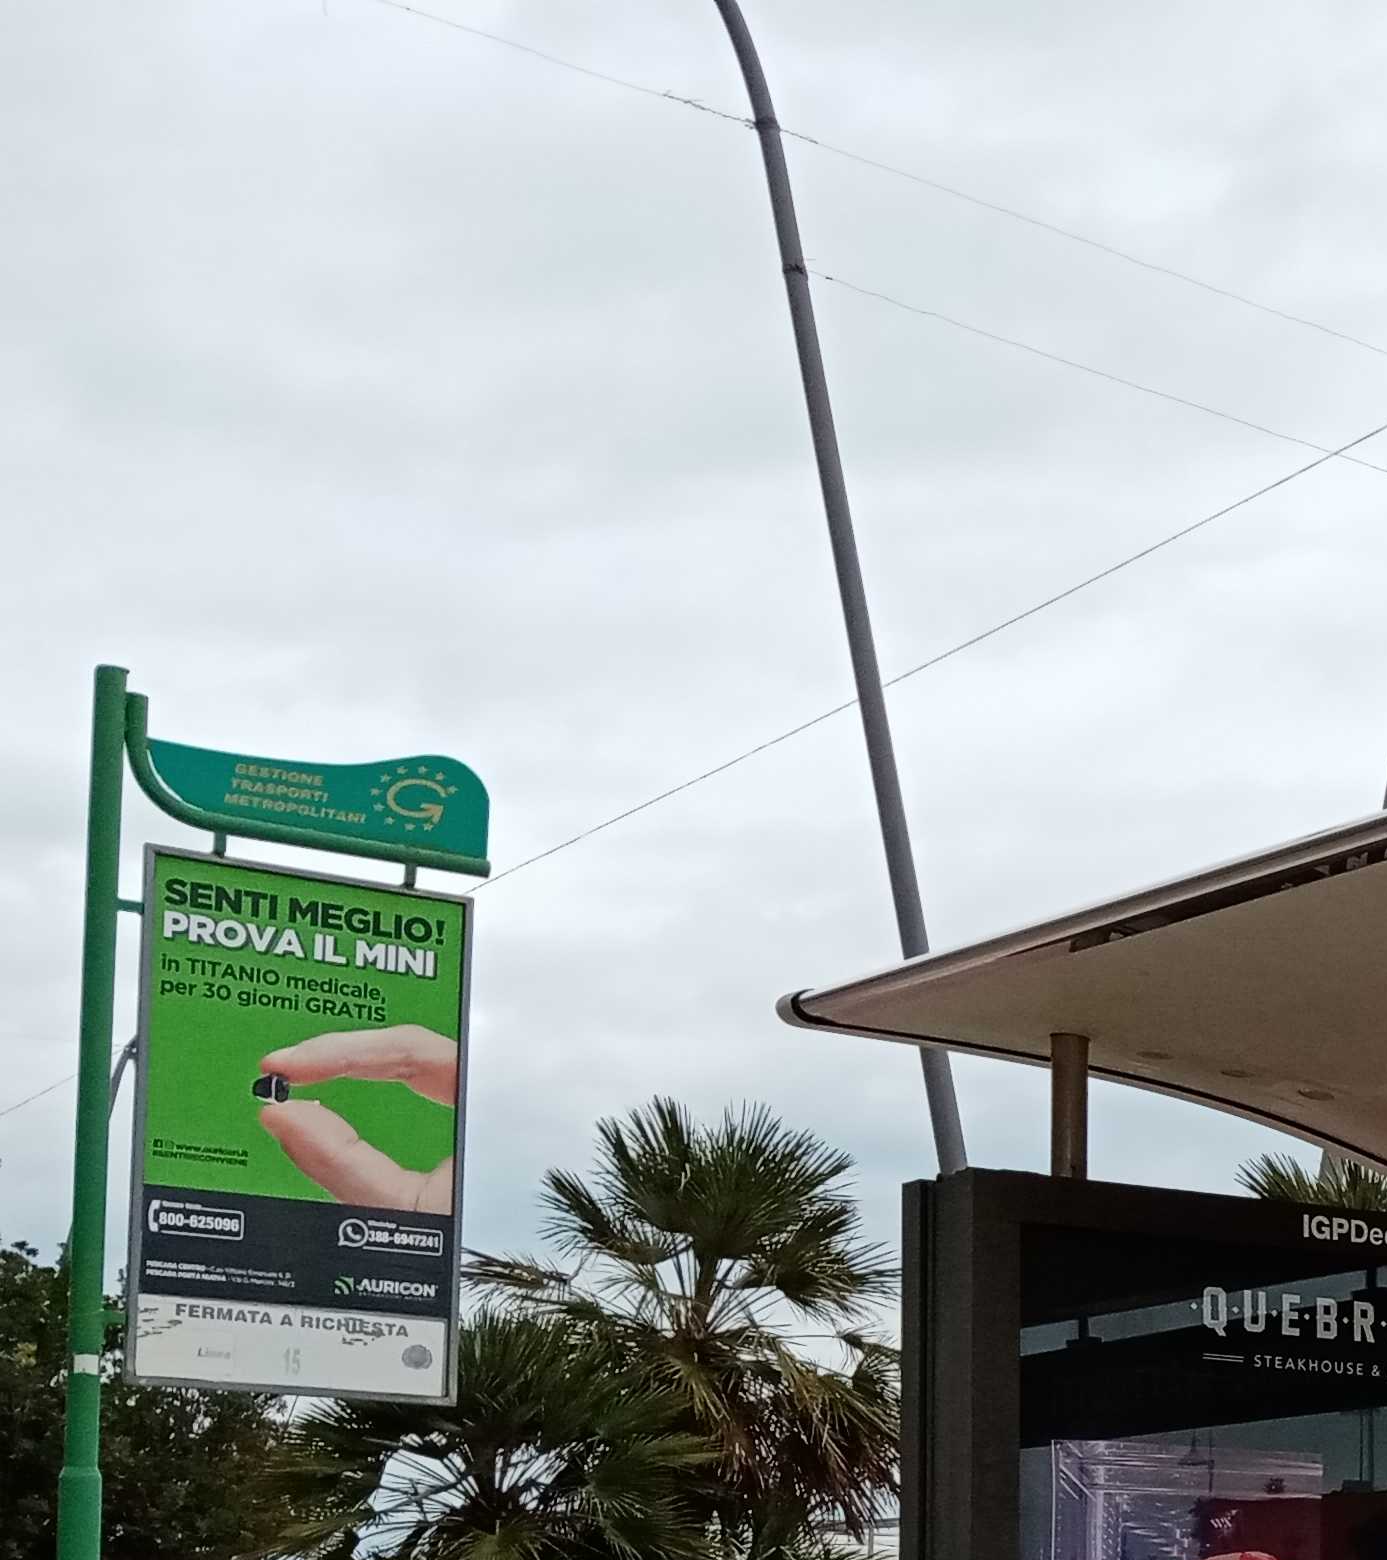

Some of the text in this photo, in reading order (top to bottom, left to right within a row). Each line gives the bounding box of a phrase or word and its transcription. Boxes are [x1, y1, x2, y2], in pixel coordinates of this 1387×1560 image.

[231, 778, 328, 802] TRASPORTI
[235, 763, 324, 786] GESTIONE
[224, 793, 366, 825] METROPOLITANI
[164, 878, 445, 945] SENTI MEGLIO!
[163, 910, 437, 979] PROVA IL MINI
[161, 953, 386, 1005] in TITANIO medicale,
[160, 979, 386, 1023] per 30 giorni GRATIS
[356, 1278, 436, 1297] AURICON
[175, 1303, 409, 1338] FERMATA A RICHIESTA
[284, 1347, 301, 1375] 15
[1254, 1354, 1365, 1377] STEAKHOUSE
[1371, 1364, 1381, 1378] &
